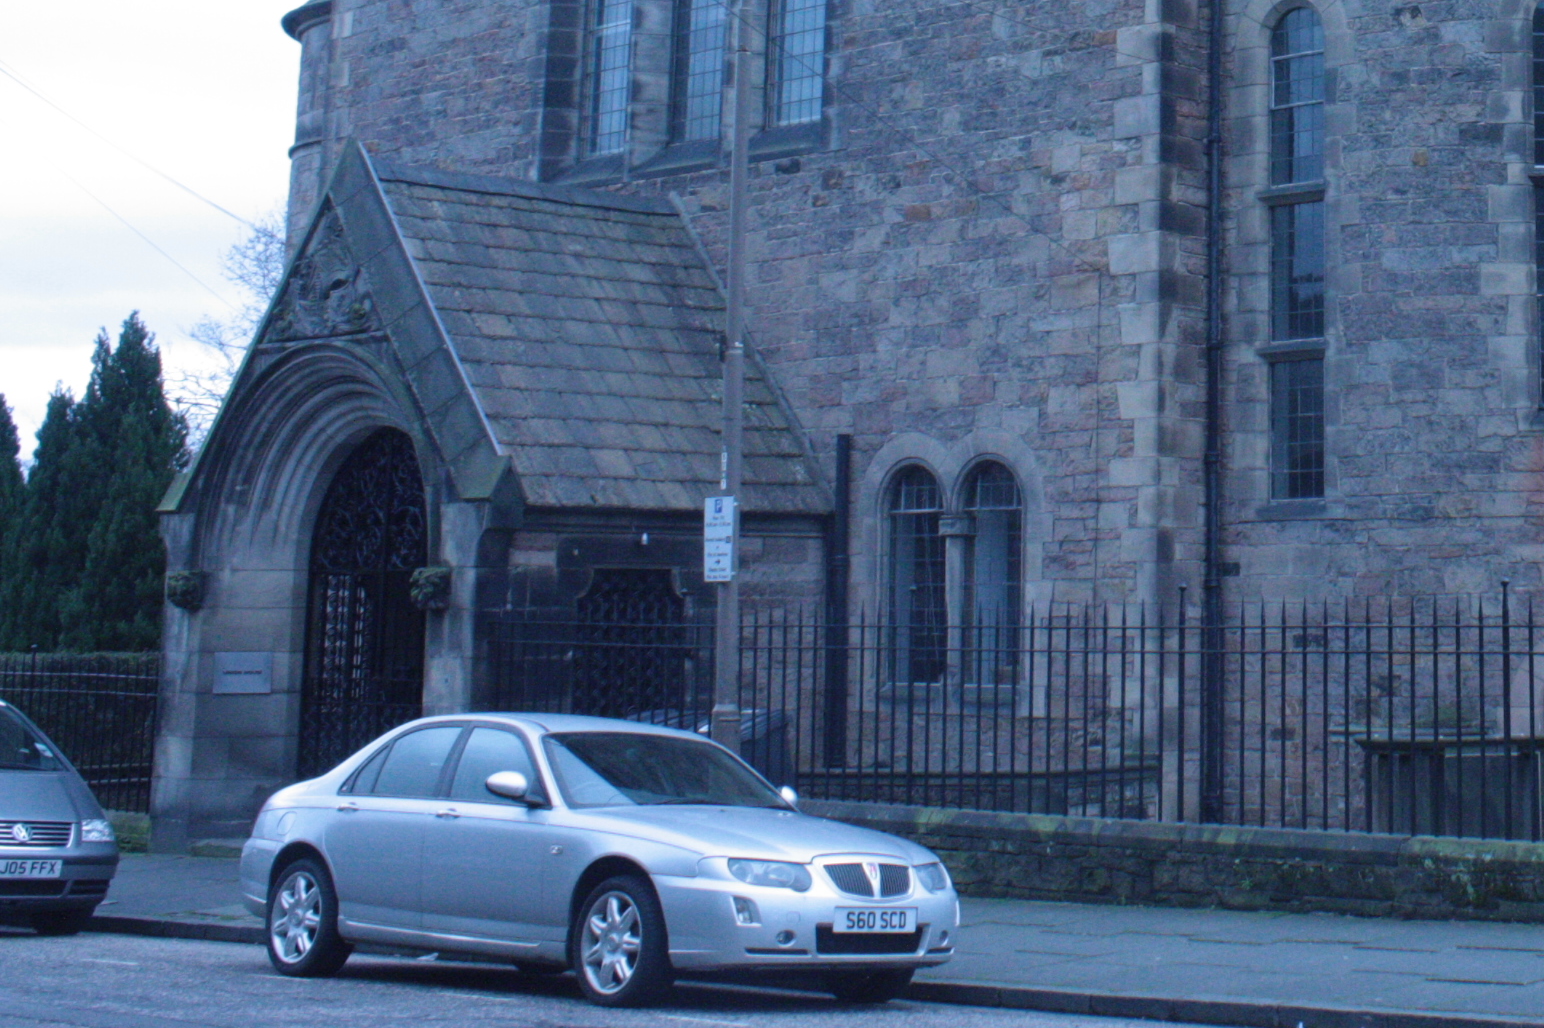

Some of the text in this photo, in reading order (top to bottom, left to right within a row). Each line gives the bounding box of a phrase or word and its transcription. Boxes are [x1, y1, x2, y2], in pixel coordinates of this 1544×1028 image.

[30, 861, 58, 874] FFX
[846, 911, 907, 929] S60 SCD
